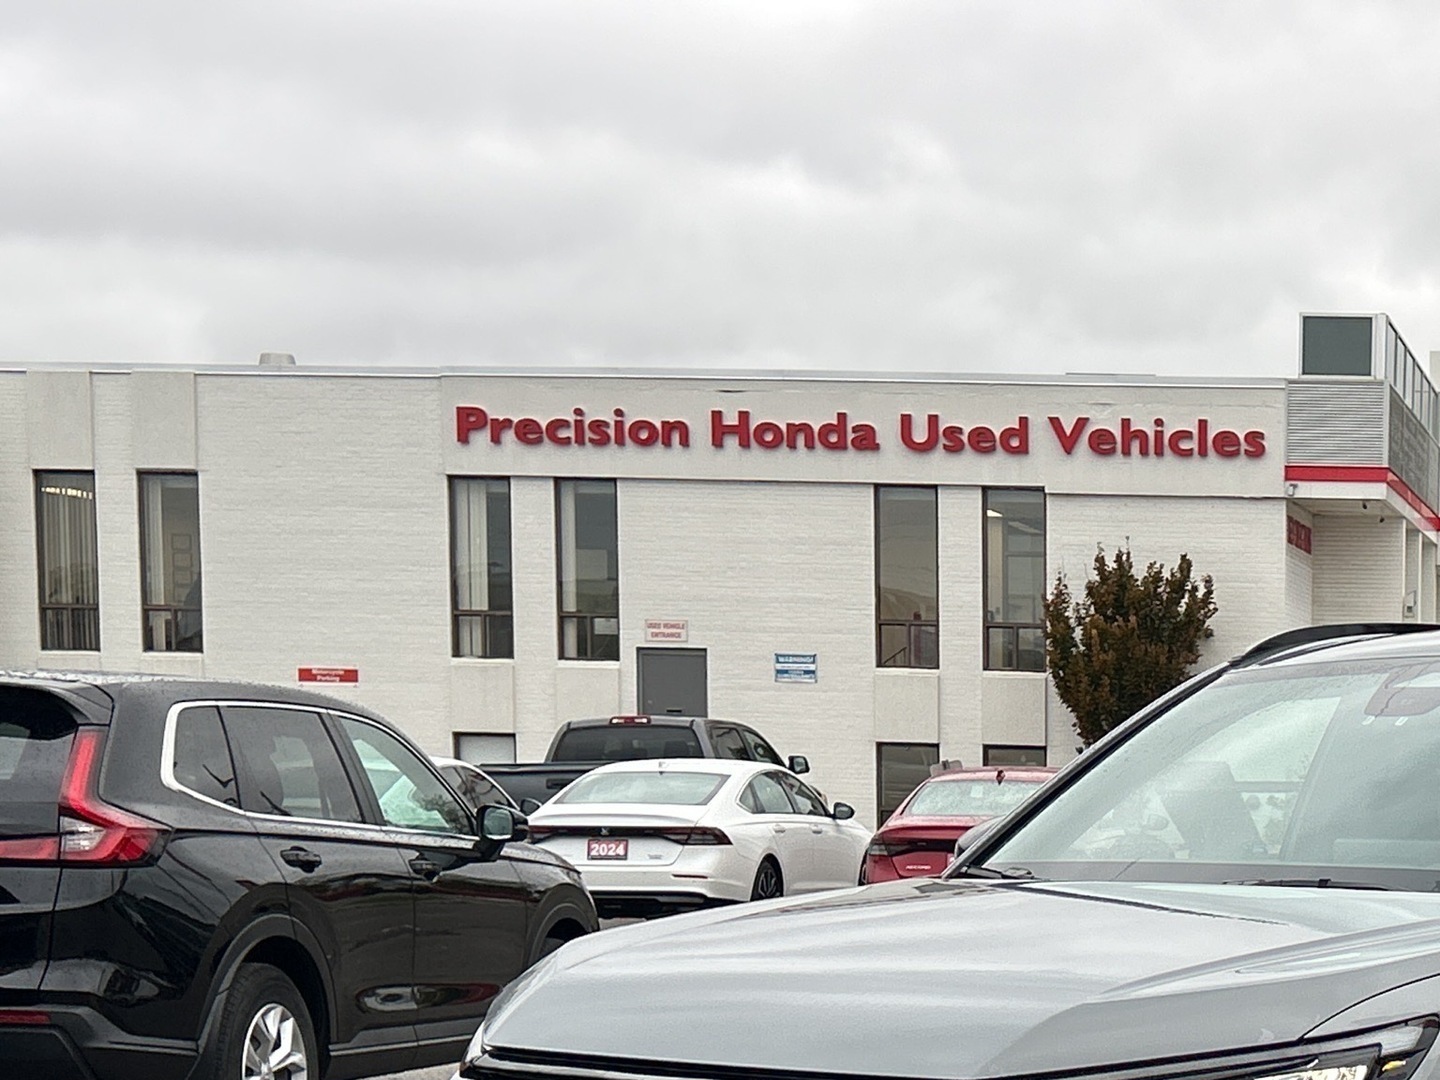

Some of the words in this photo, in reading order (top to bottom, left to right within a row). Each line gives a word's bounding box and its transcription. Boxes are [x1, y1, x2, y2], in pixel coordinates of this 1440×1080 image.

[457, 407, 689, 447] Precision
[712, 411, 879, 450] Honda
[901, 414, 1029, 454] Used
[1049, 417, 1266, 457] Vehicles
[590, 843, 626, 856] 2024
